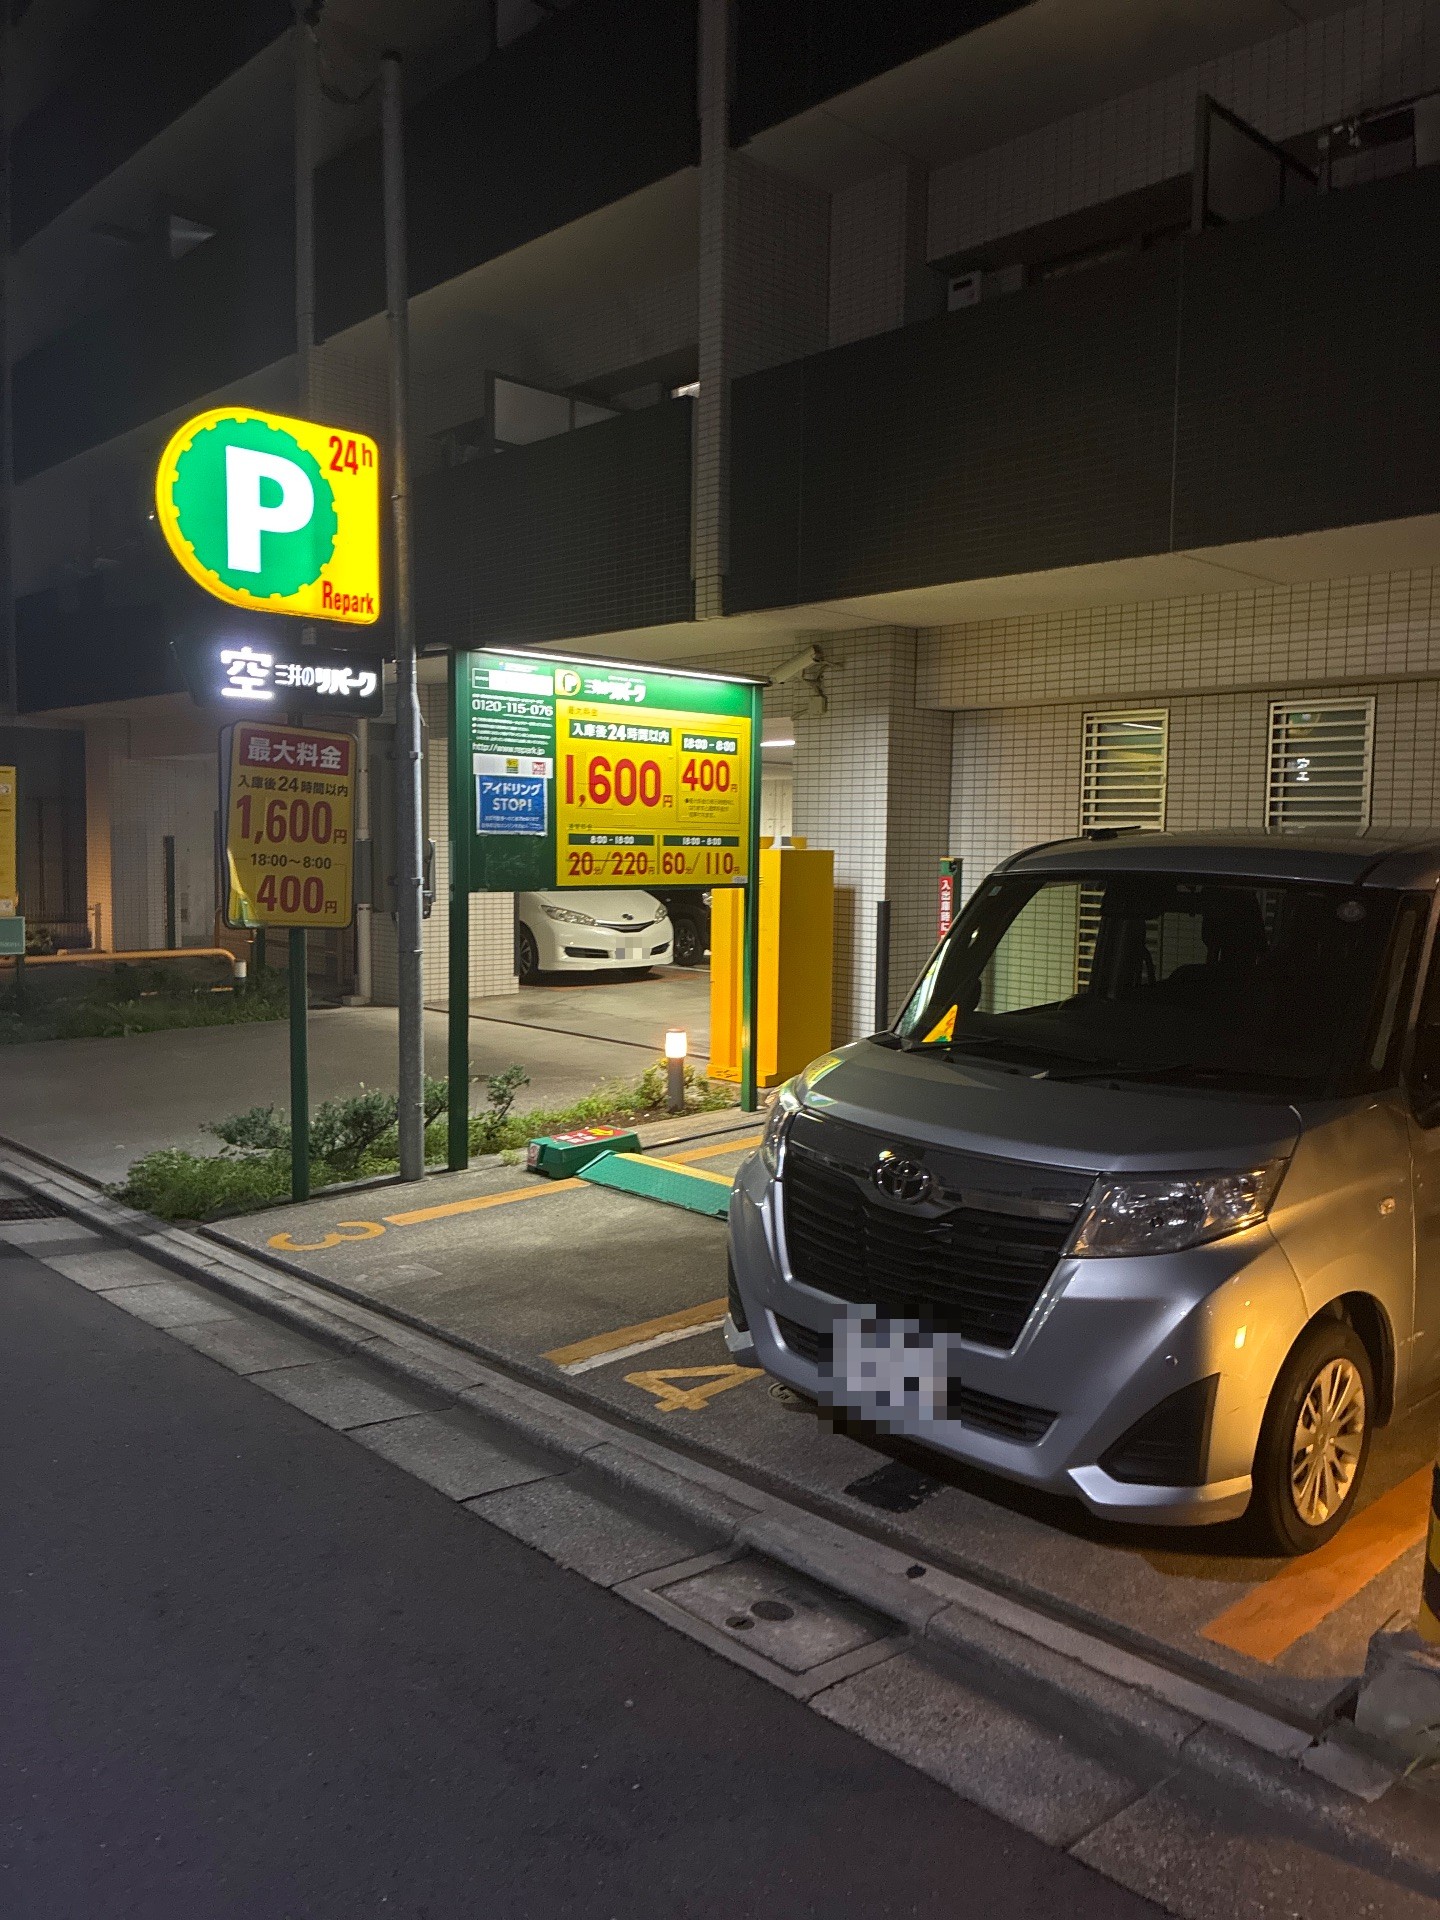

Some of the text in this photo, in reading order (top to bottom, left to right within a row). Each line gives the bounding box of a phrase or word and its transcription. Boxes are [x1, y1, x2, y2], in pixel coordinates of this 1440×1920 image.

[329, 435, 373, 475] 24h
[225, 445, 315, 573] P
[322, 580, 374, 615] Repark
[220, 646, 377, 699] 空 三井のリパーク
[472, 699, 554, 716] 0120-115-076
[248, 737, 342, 770] 最大料金
[238, 775, 348, 798] 入庫後24時間以内
[482, 782, 542, 796] アイドリング
[492, 798, 533, 811] STOP!
[267, 1221, 386, 1251] 3
[623, 1363, 765, 1412] 4
